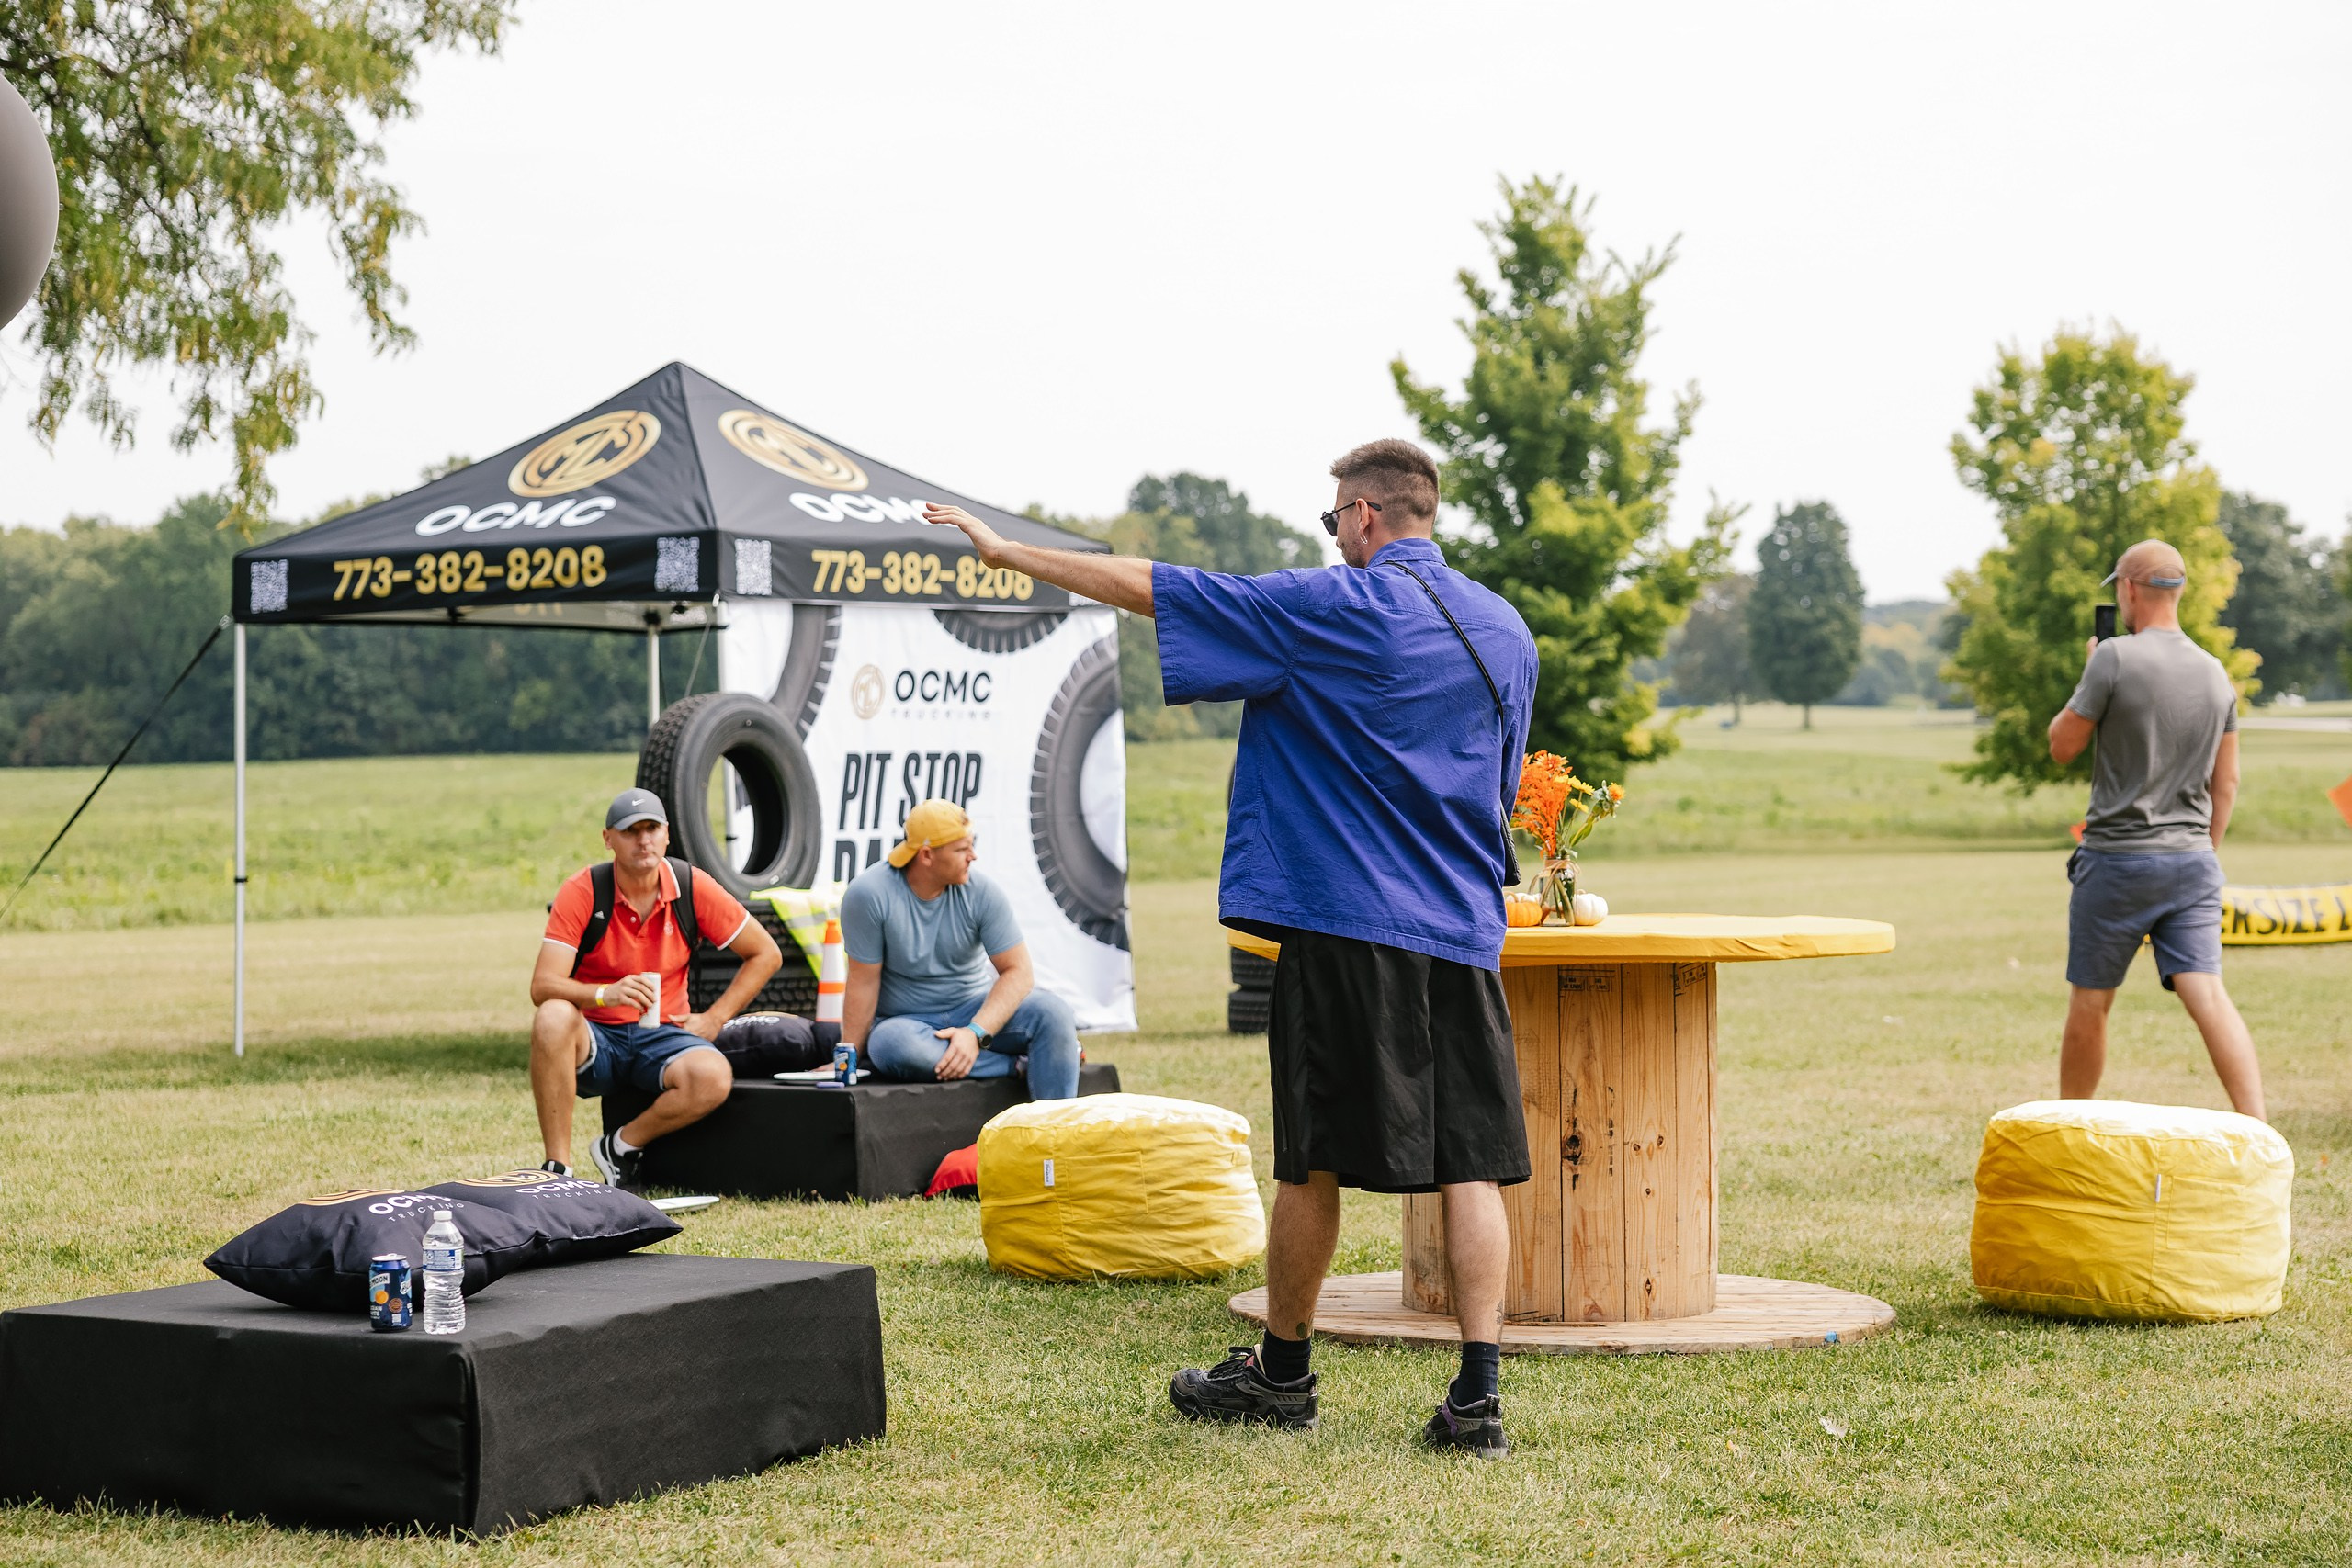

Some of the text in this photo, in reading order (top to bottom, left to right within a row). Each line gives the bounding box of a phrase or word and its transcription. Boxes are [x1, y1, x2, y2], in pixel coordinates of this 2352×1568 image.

[415, 496, 616, 536] OCMC
[333, 545, 607, 601] 773-382-8208
[811, 549, 1035, 601] 773-382-8208
[895, 670, 991, 703] OCMC
[839, 752, 982, 830] PIT STOP
[515, 1180, 600, 1192] OCMC
[532, 1189, 612, 1200] TRUCKING
[368, 1195, 451, 1214] OCM
[389, 1202, 464, 1222] TRUCKING
